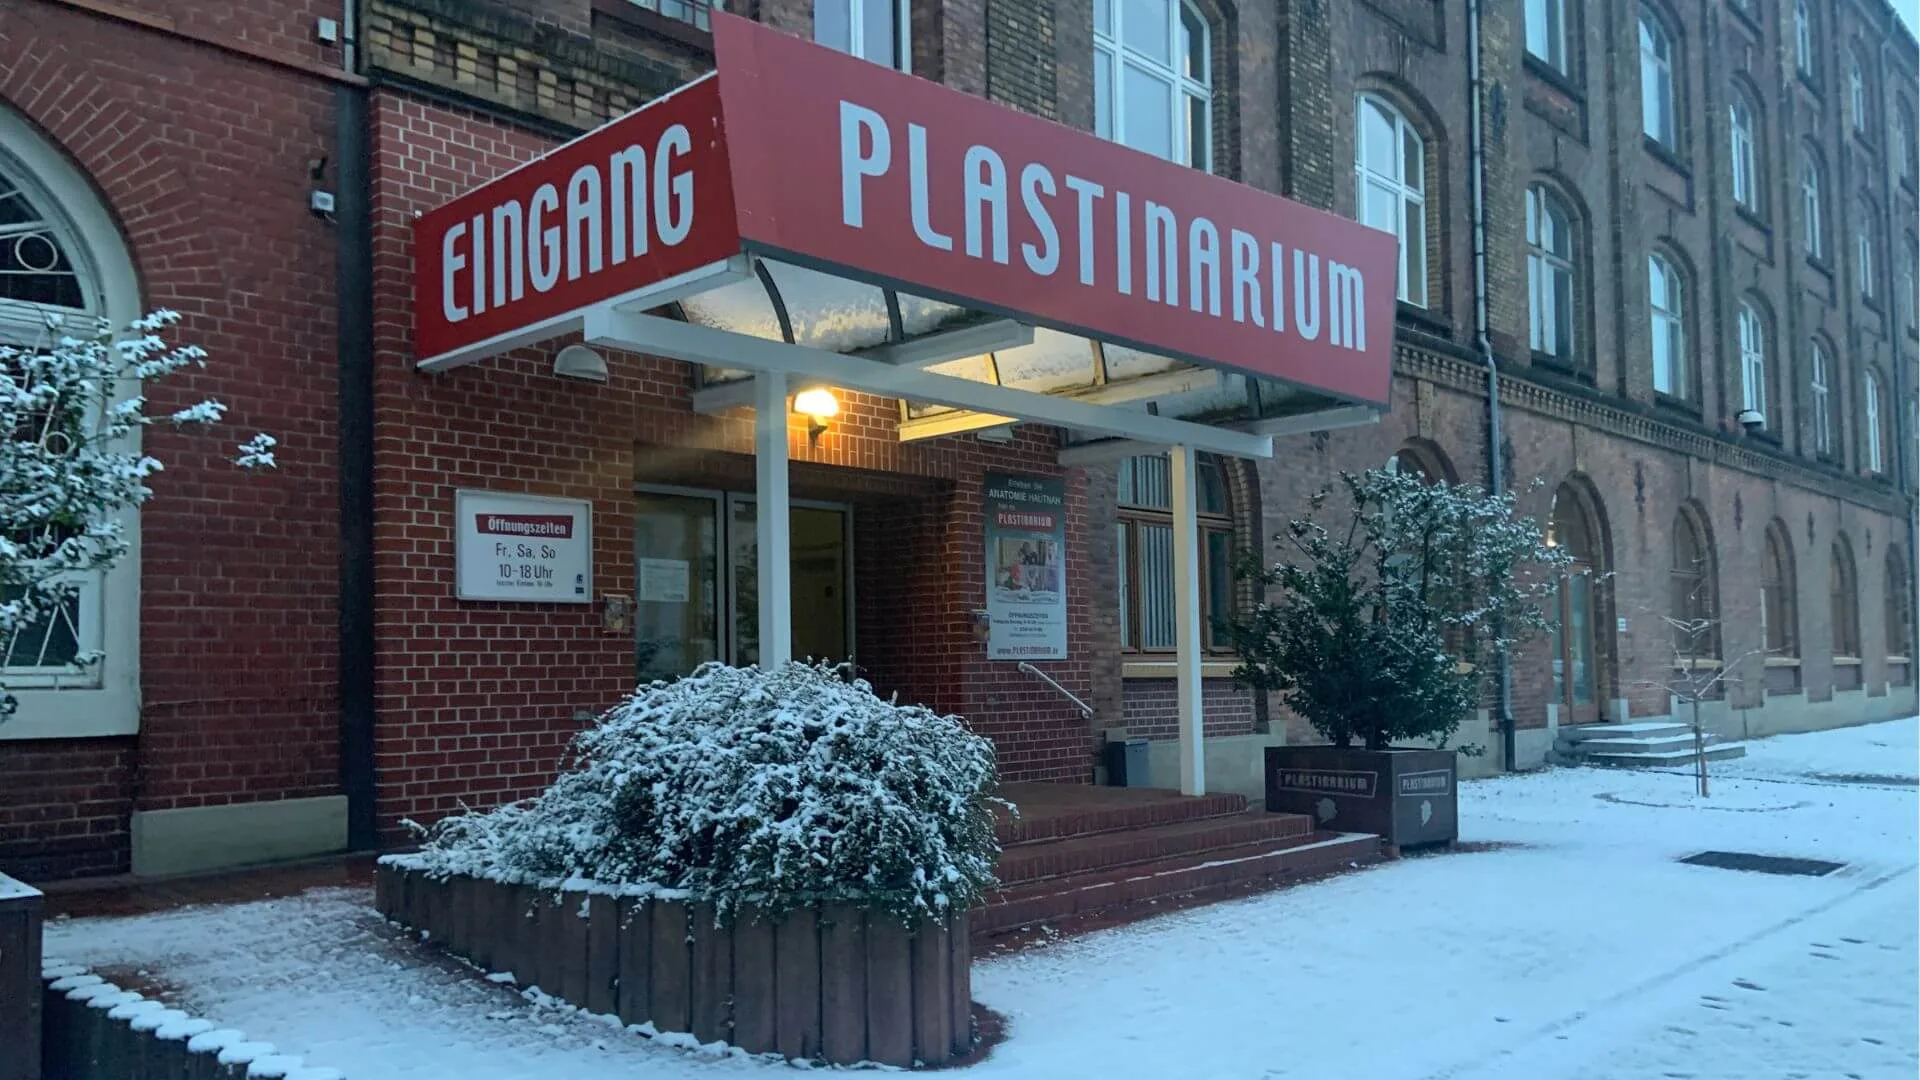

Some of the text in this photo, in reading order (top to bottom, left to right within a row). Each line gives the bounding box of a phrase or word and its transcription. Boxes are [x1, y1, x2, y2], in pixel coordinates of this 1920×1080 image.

[442, 123, 694, 323] EINGANG
[839, 99, 1367, 352] PLASTINARIUM
[988, 488, 1027, 501] ANATOMIE
[487, 515, 567, 536] Öffnungszeiten
[998, 512, 1052, 528] PLASTINARIUM
[541, 544, 556, 560] So
[534, 565, 554, 580] Uhr
[1284, 773, 1368, 790] PLASTINARIUM
[1402, 775, 1446, 791] PLASTINARIUM
